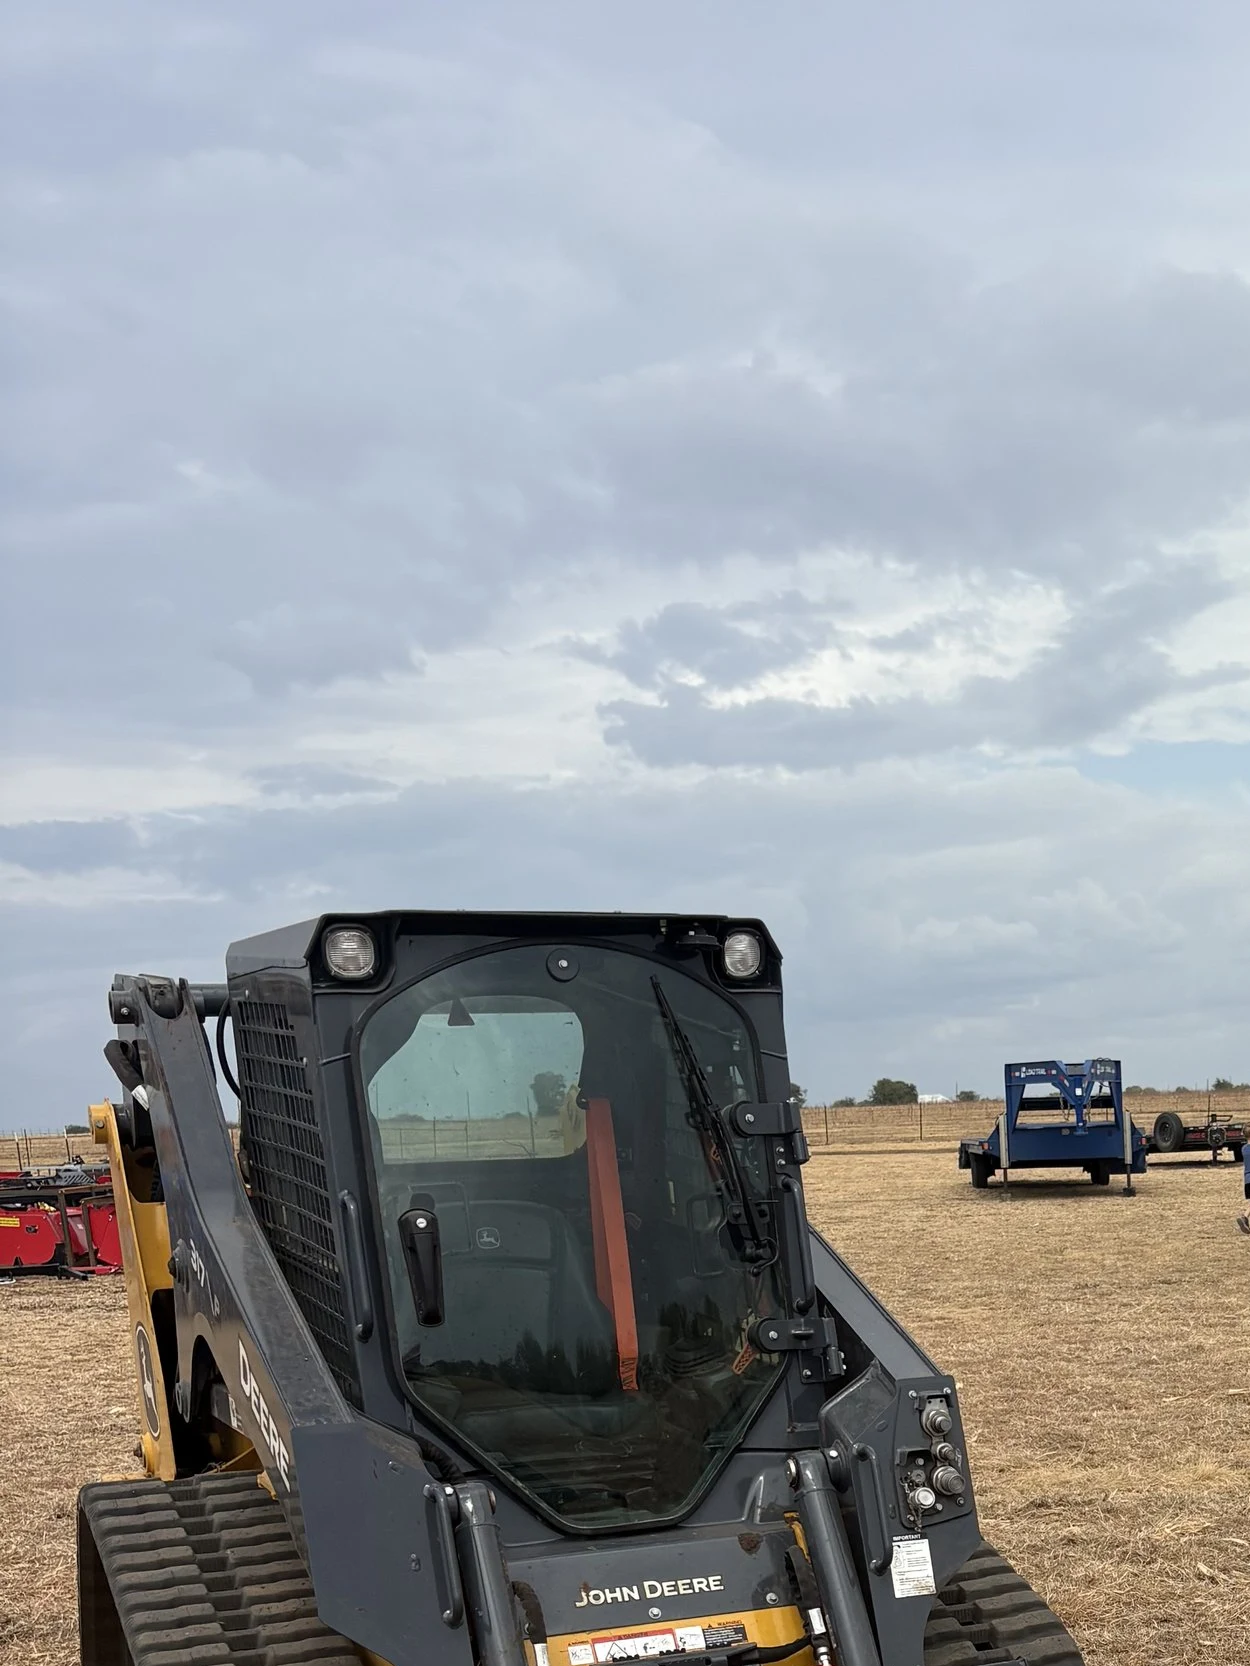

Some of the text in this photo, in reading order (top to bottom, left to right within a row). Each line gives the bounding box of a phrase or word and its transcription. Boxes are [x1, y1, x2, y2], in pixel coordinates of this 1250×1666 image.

[238, 1337, 291, 1494] DEERE
[892, 1534, 921, 1542] IMPORTANT
[575, 1575, 724, 1608] JOHN DEERE
